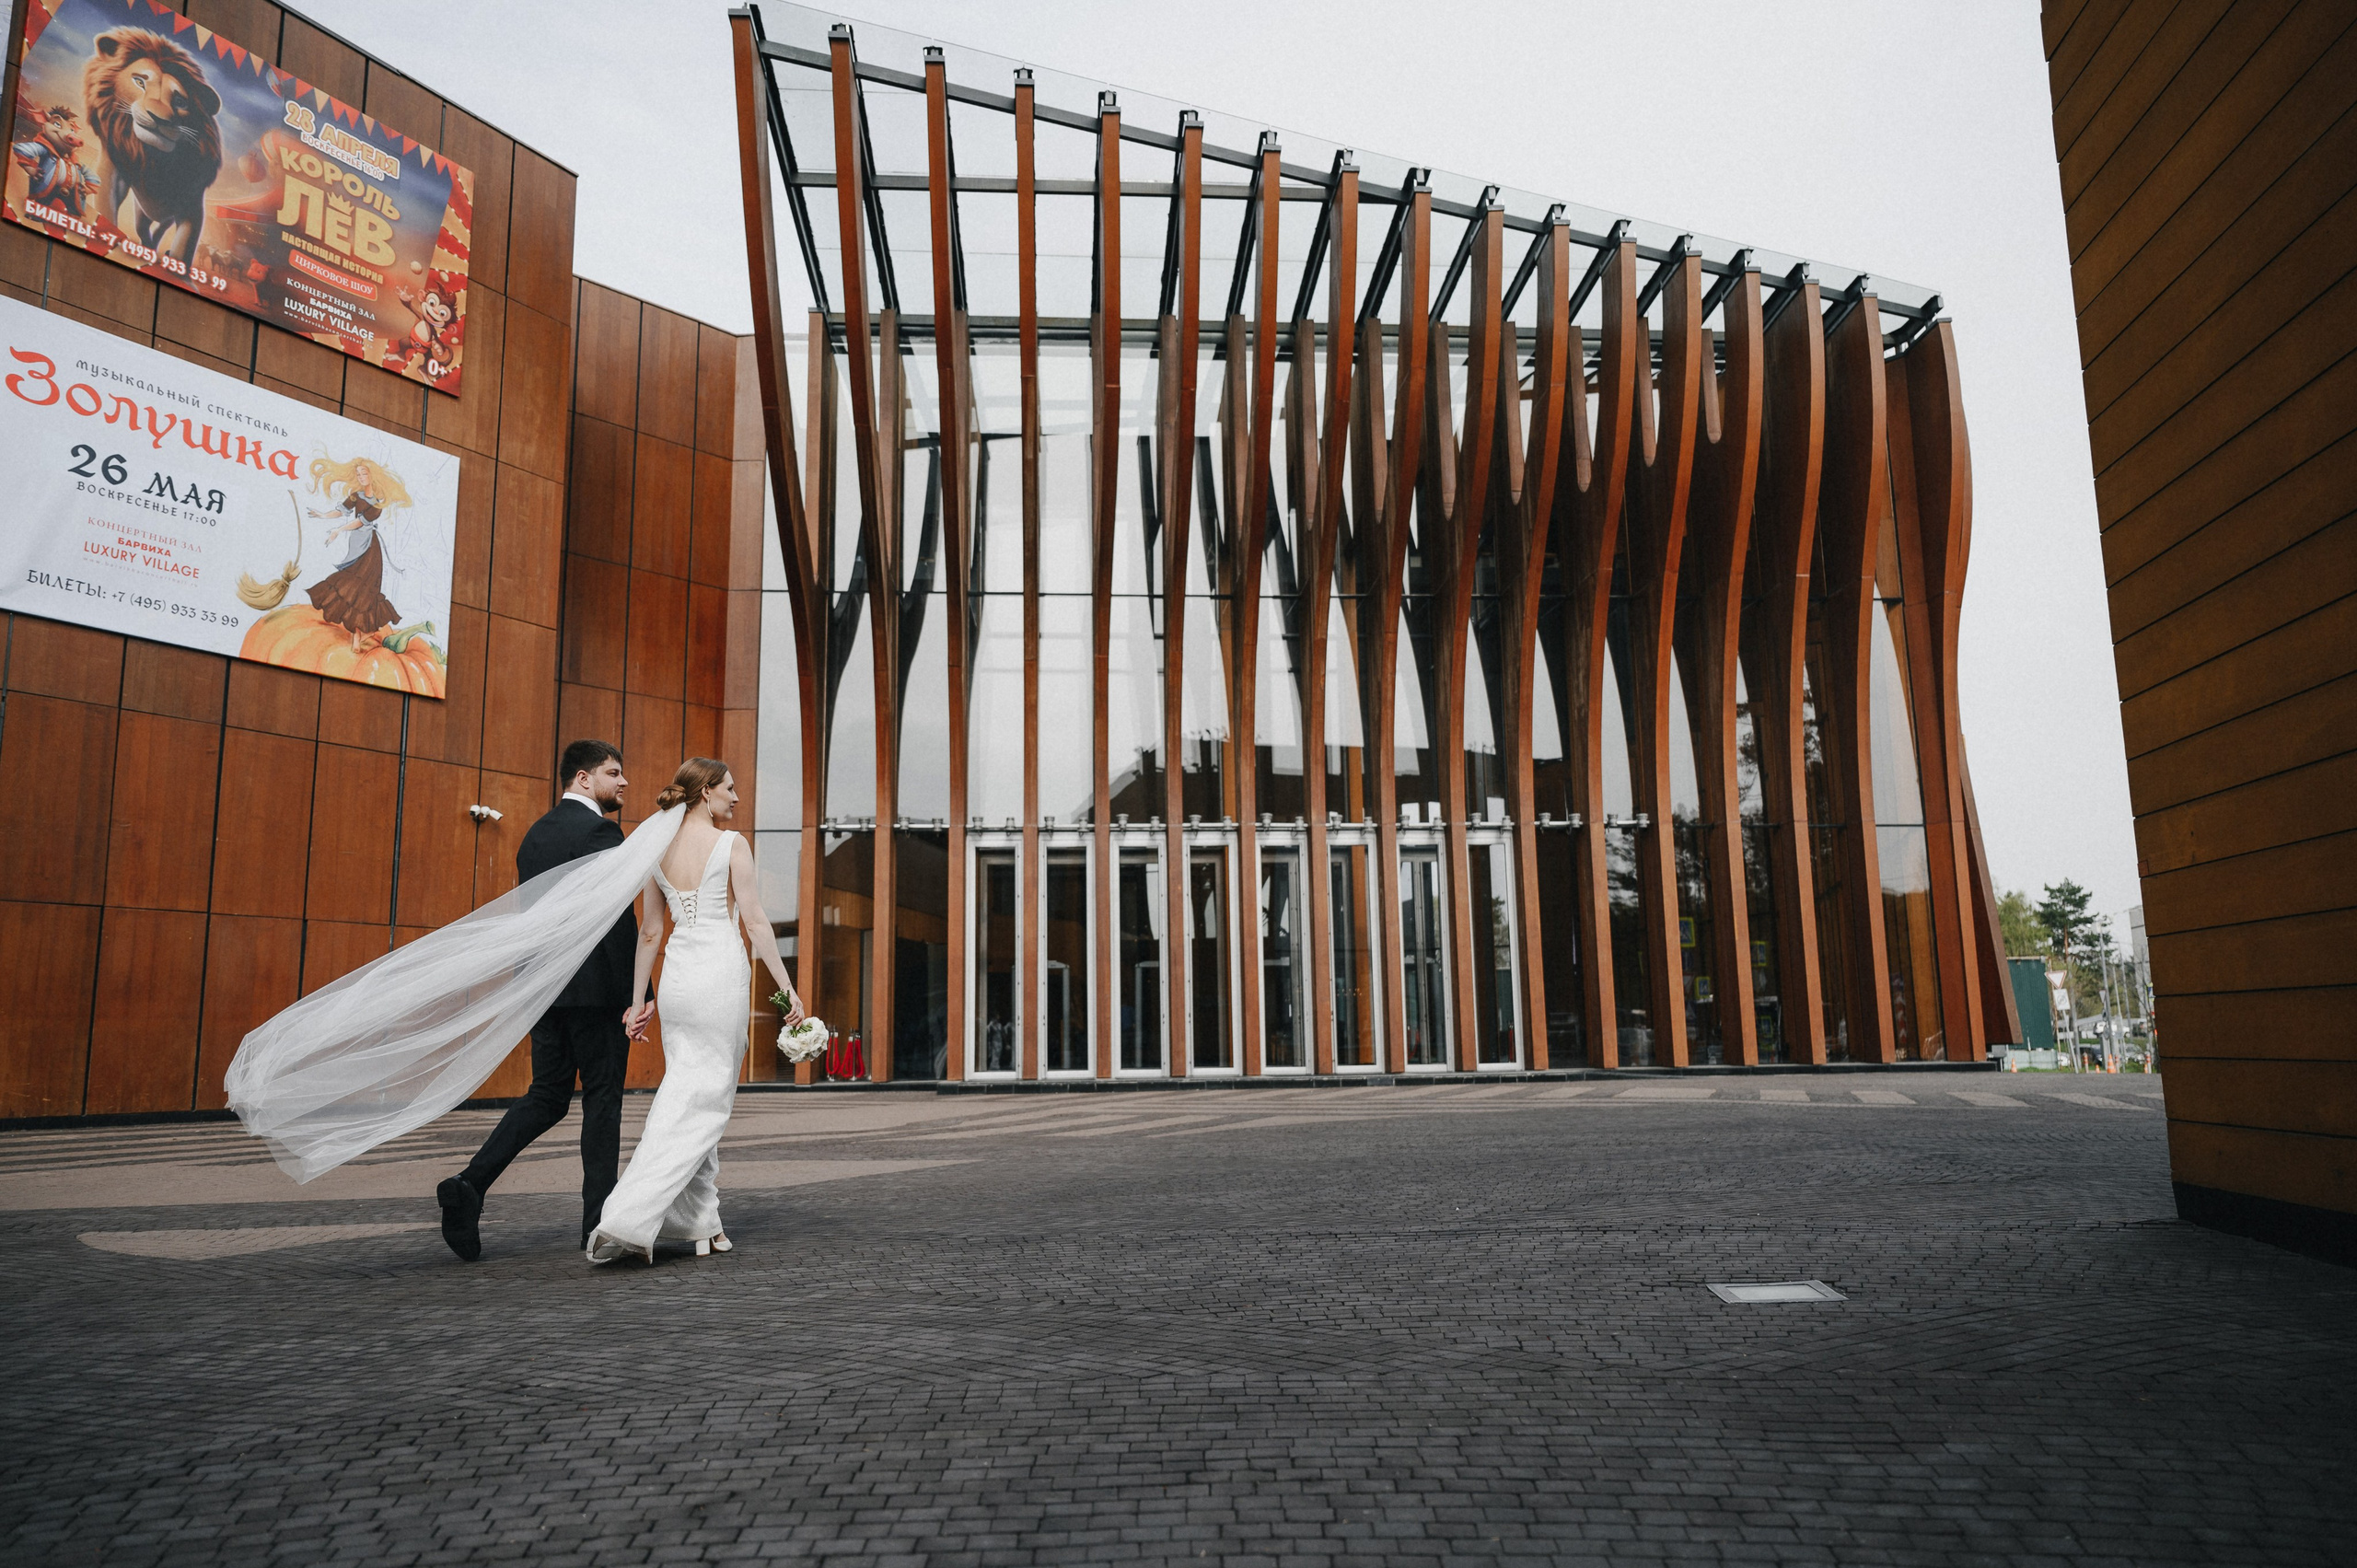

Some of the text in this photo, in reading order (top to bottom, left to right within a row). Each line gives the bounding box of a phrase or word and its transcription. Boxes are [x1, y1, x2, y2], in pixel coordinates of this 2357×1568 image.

[284, 101, 400, 180] 28 АПРЕЛЯ
[302, 133, 361, 168] ВОСКРЕСЕНЬЕ
[279, 145, 401, 220] КОРОЛЬ
[277, 174, 396, 267] ЛЕВ
[25, 199, 226, 291] БИЛЕТЫ: +7 (495) 933 33 99
[282, 230, 384, 285] НАСТОЯЩАЯ ИСТОРИЯ
[295, 254, 374, 295] ЦИРКОВОЕ ШОУ
[284, 296, 375, 342] LUXURY VILLAGE
[286, 277, 377, 321] КОНЦЕРТНЫЙ ЗАЛ
[309, 297, 353, 321] БАРВИХА
[428, 358, 447, 377] 0+
[5, 346, 300, 481] Золушка
[75, 358, 289, 437] музыкальный спектакль
[67, 444, 227, 515] 26 МАЯ
[76, 481, 216, 527] ВОСКРЕСЕНЬЕ 17:00
[87, 517, 202, 553] КОНЦЕРТНЫЙ ЗАЛ
[117, 537, 171, 557] БАРВИХА
[84, 540, 200, 579] LUXURY VILLAGE
[26, 569, 238, 628] БИЛЕТЫ: +7 (495) 933 33 99
